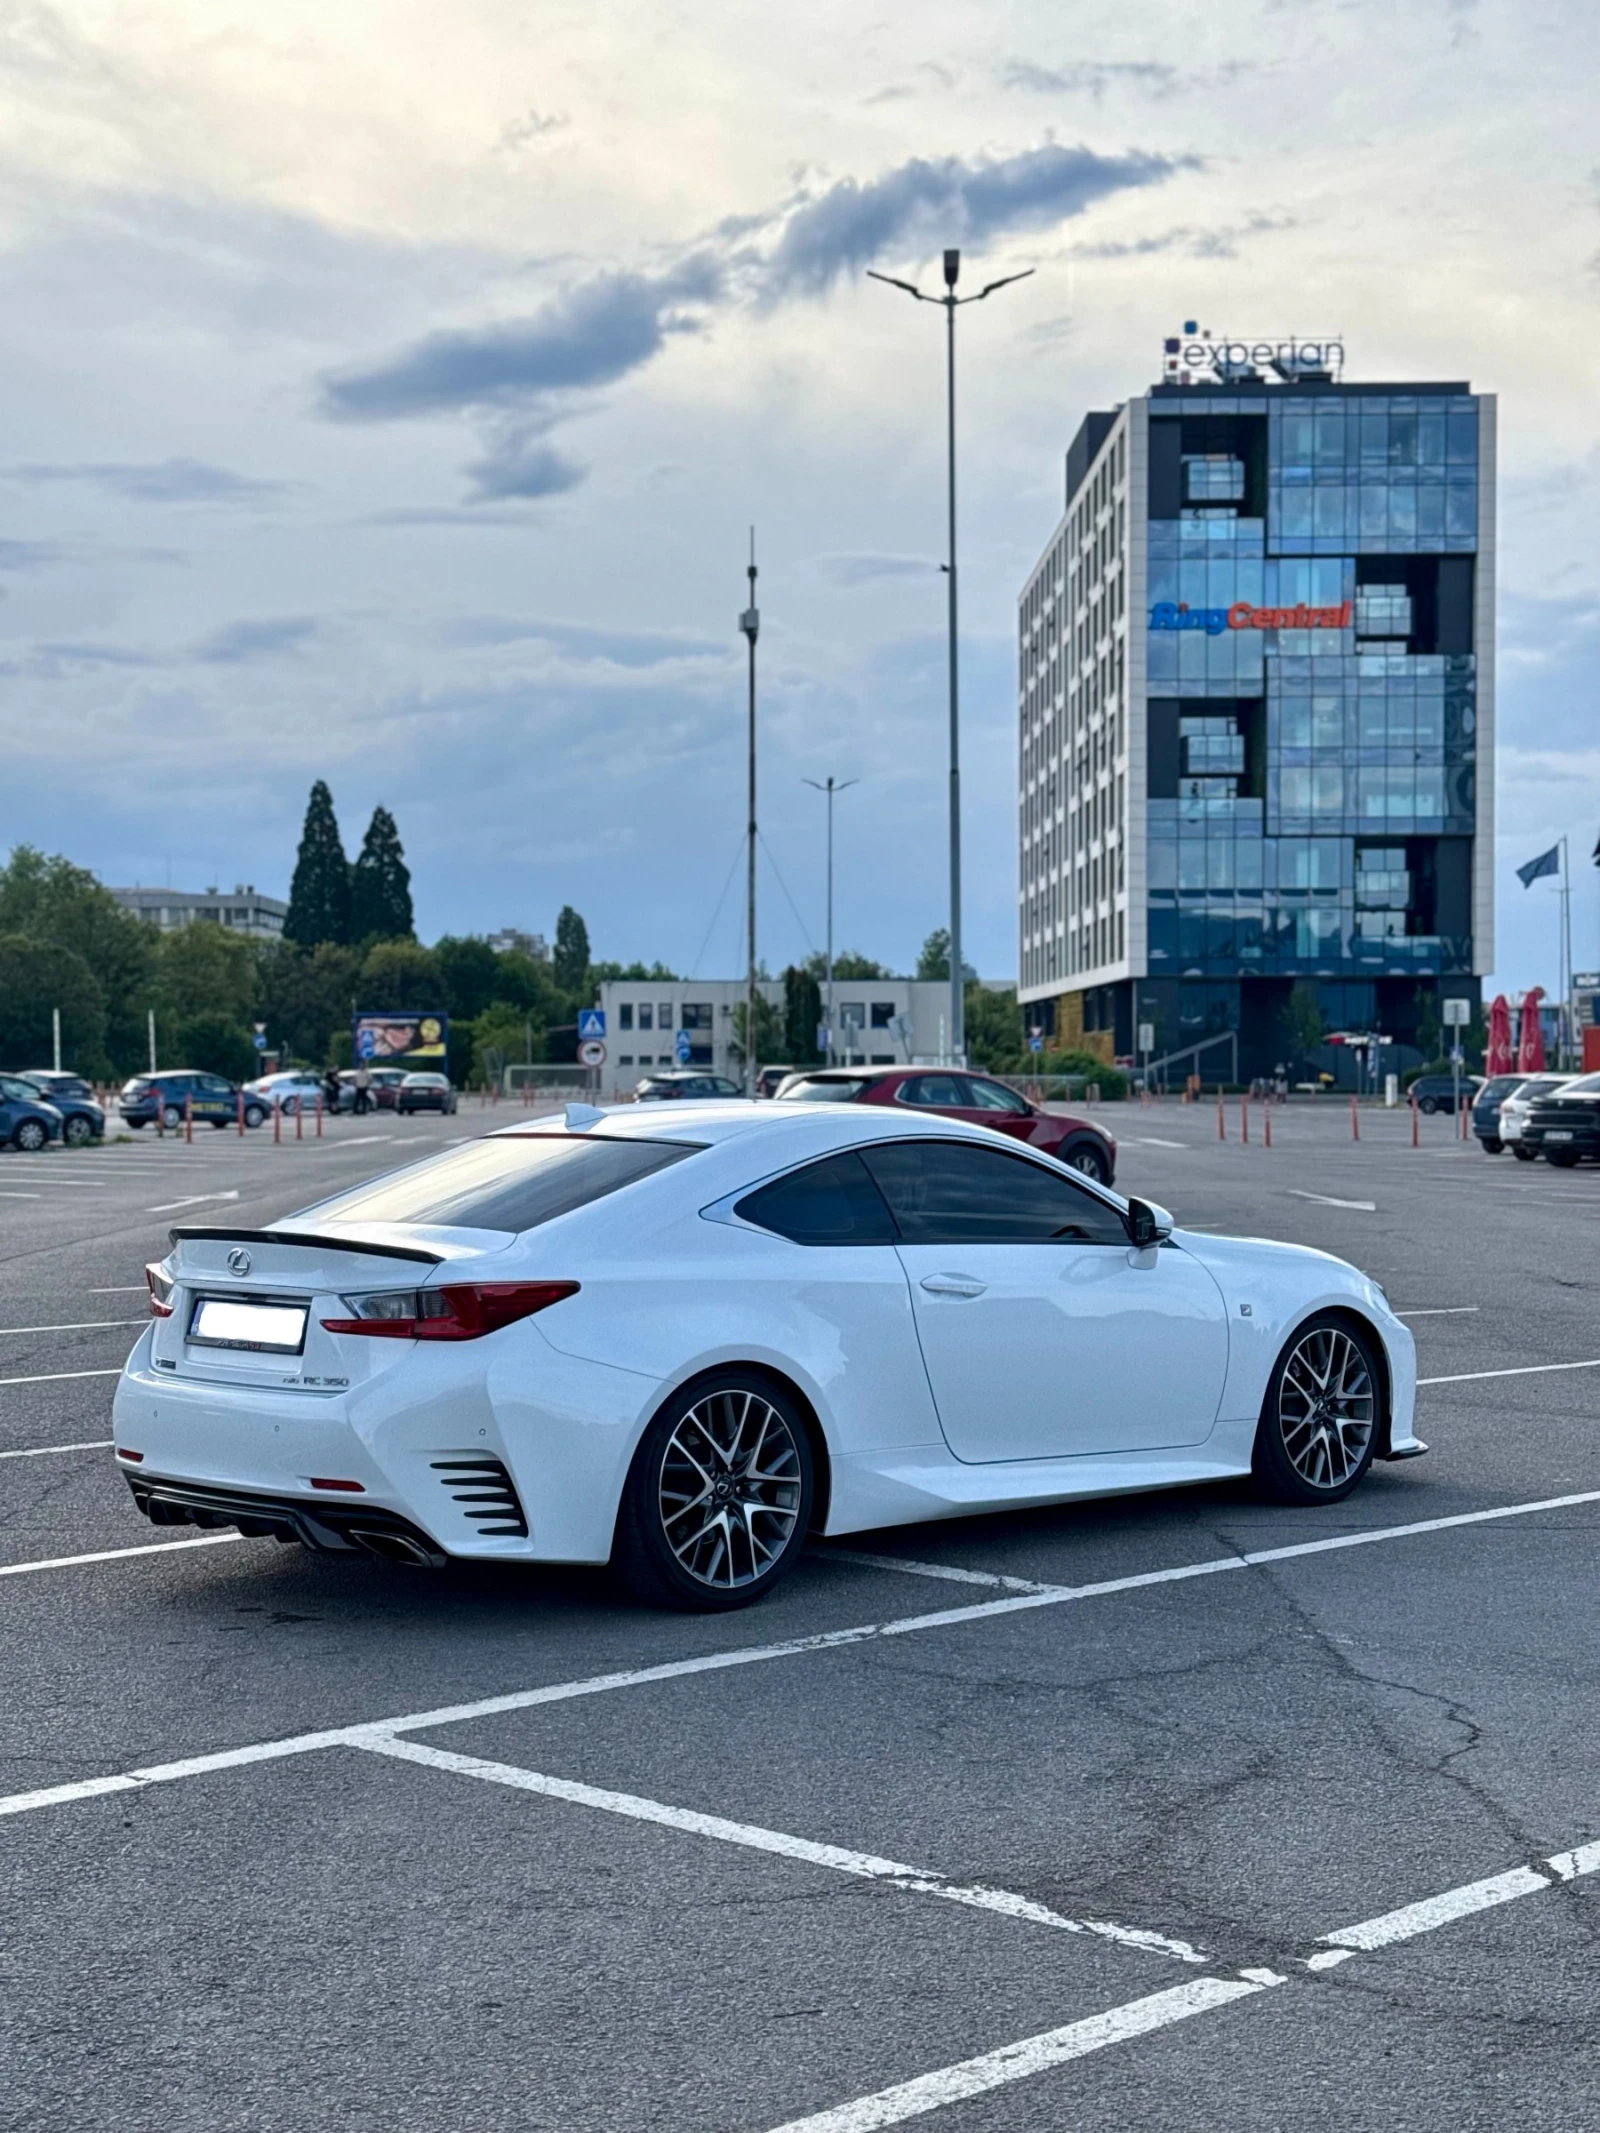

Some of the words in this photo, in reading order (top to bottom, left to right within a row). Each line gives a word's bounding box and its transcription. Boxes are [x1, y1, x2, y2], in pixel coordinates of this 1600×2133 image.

[1183, 342, 1345, 374] experian
[1151, 600, 1351, 635] RingCentral
[303, 1376, 321, 1386] RC
[323, 1377, 350, 1387] 350
